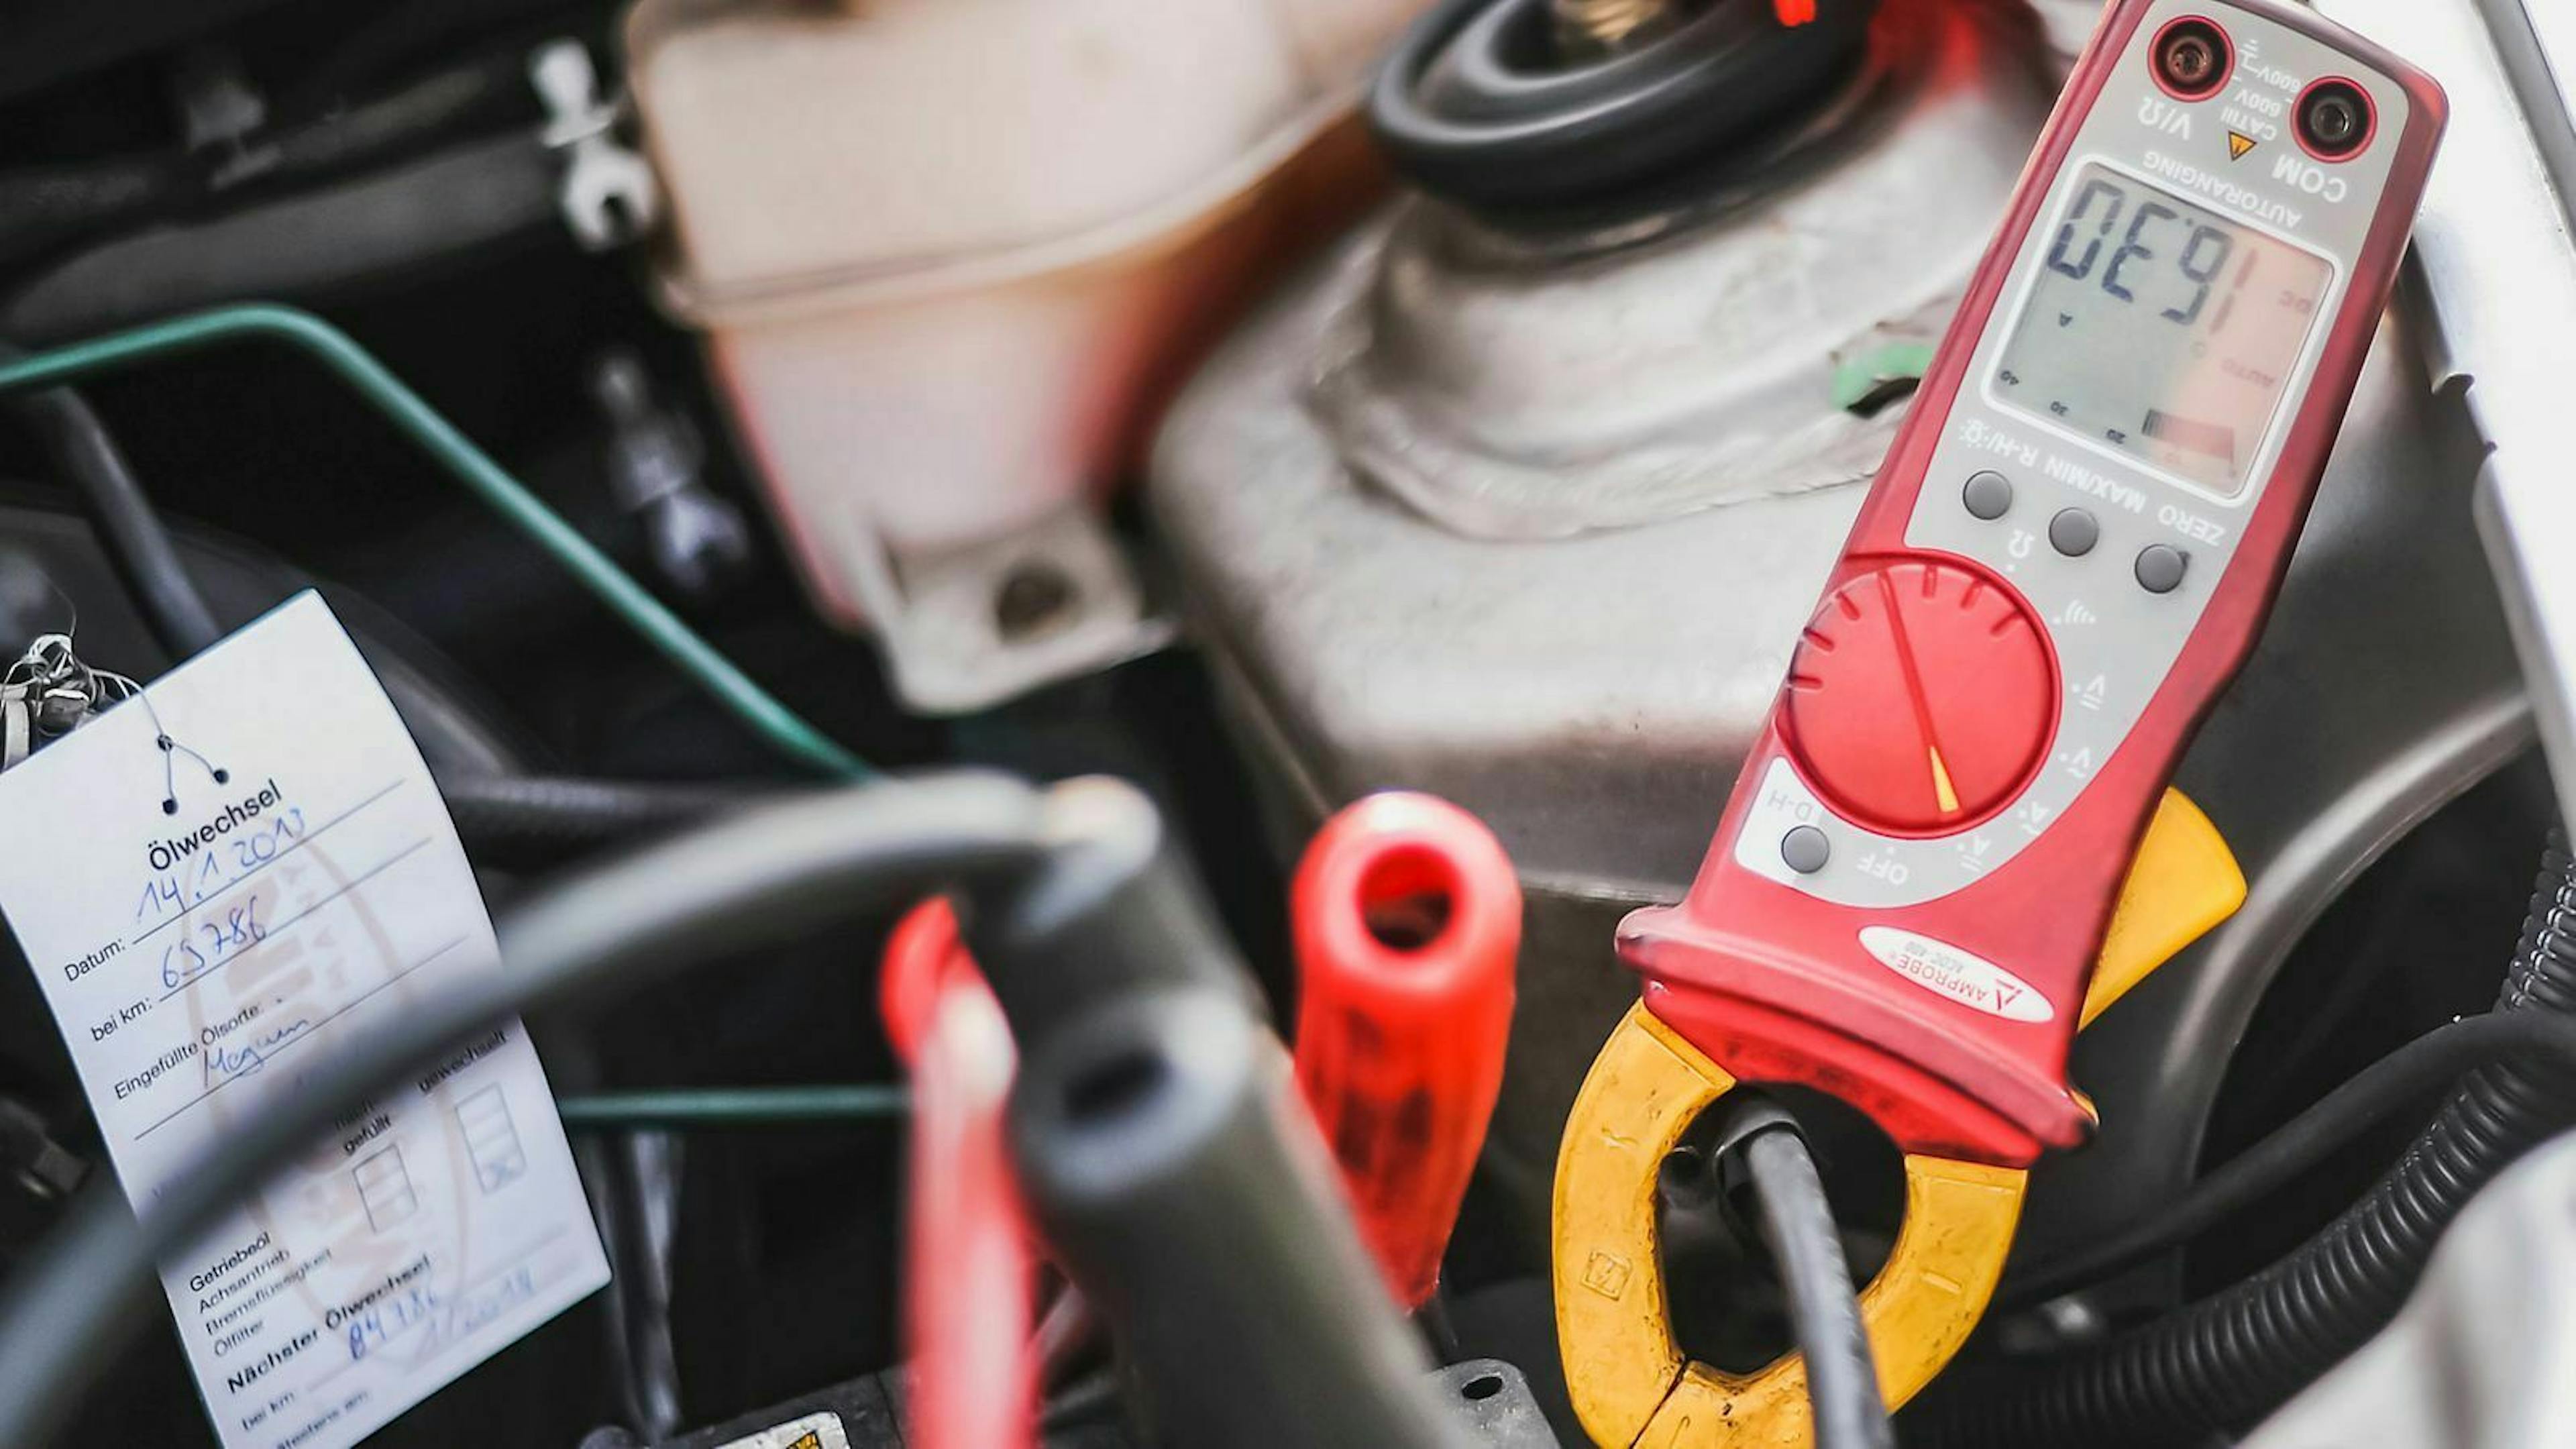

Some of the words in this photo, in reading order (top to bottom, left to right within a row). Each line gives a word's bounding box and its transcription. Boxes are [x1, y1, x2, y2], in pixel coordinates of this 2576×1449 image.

[2257, 66, 2302, 93] 600V
[2234, 89, 2282, 118] 600V
[2142, 150, 2303, 228] AUTORANGING
[2271, 154, 2348, 203] COM
[2059, 312, 2074, 327] A
[2000, 370, 2020, 386] 40
[2106, 428, 2127, 445] 20
[2043, 453, 2147, 515] MAX/MIN
[2157, 504, 2228, 547] ZERO
[148, 778, 282, 871] Ölwechsel
[1856, 853, 1909, 885] OFF
[64, 938, 126, 981] Datum:
[91, 1016, 119, 1042] bei
[119, 998, 153, 1025] km:
[114, 1042, 199, 1100] Eingefüllte
[189, 1230, 271, 1293] Getriebeöl
[199, 1248, 290, 1314] Achsantrieb
[227, 1328, 320, 1394] Nächster
[325, 1252, 431, 1331] Ölwechsel
